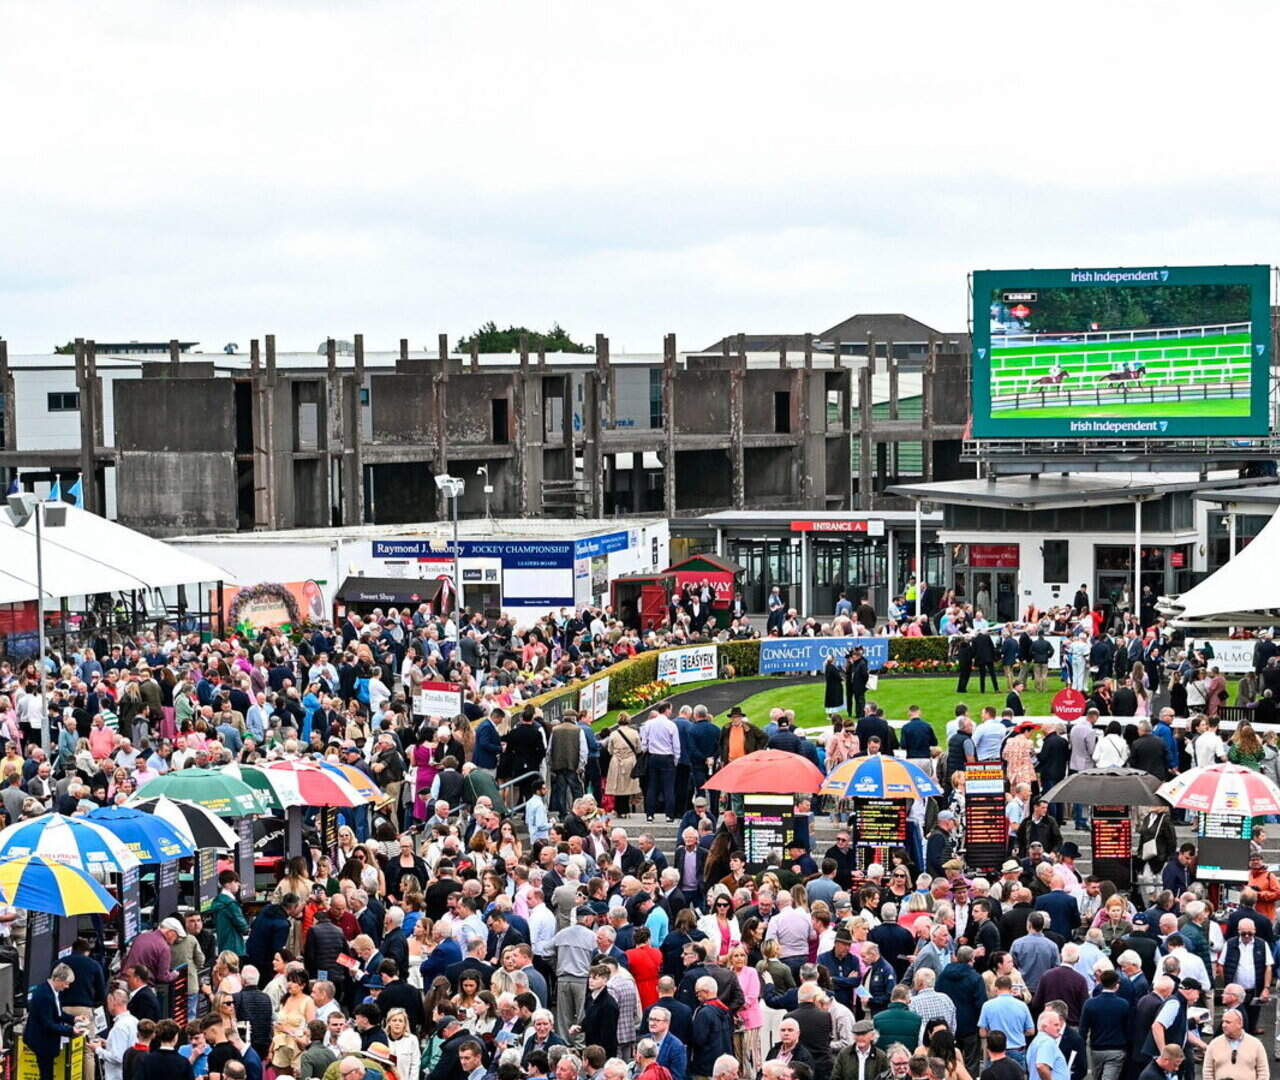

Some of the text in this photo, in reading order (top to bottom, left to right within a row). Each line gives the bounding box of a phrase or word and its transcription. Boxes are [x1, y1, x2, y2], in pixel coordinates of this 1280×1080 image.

[1071, 271, 1158, 284] Irish Independent
[1070, 421, 1157, 433] Irish Independent
[812, 522, 862, 531] ENTRANCE A
[377, 543, 429, 555] Raymond J.
[471, 545, 504, 554] JOCKEY
[505, 545, 570, 554] CHAMPIONSHIP
[1055, 705, 1082, 713] Winner
